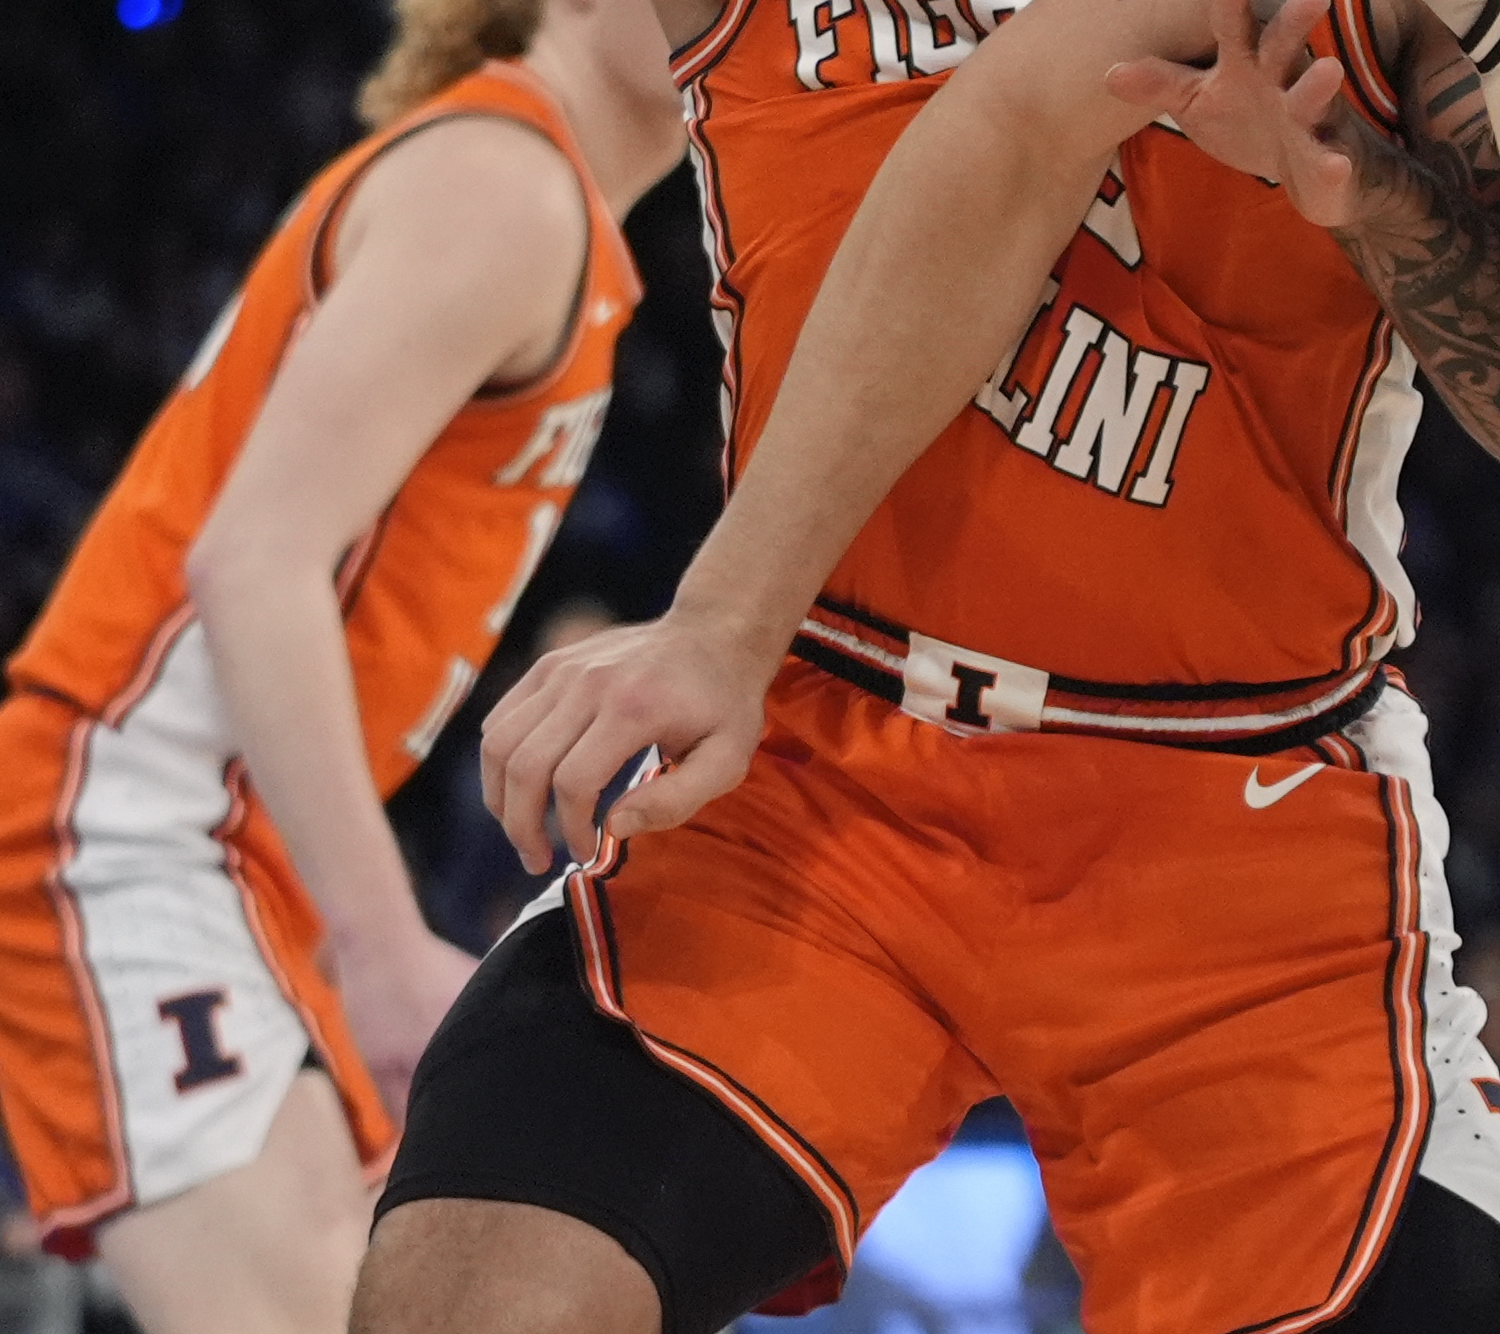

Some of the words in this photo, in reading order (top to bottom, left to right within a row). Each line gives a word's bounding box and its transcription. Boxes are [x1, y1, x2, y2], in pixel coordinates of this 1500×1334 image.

[974, 273, 1212, 508] LINI
[946, 661, 998, 730] I
[157, 986, 244, 1095] I
